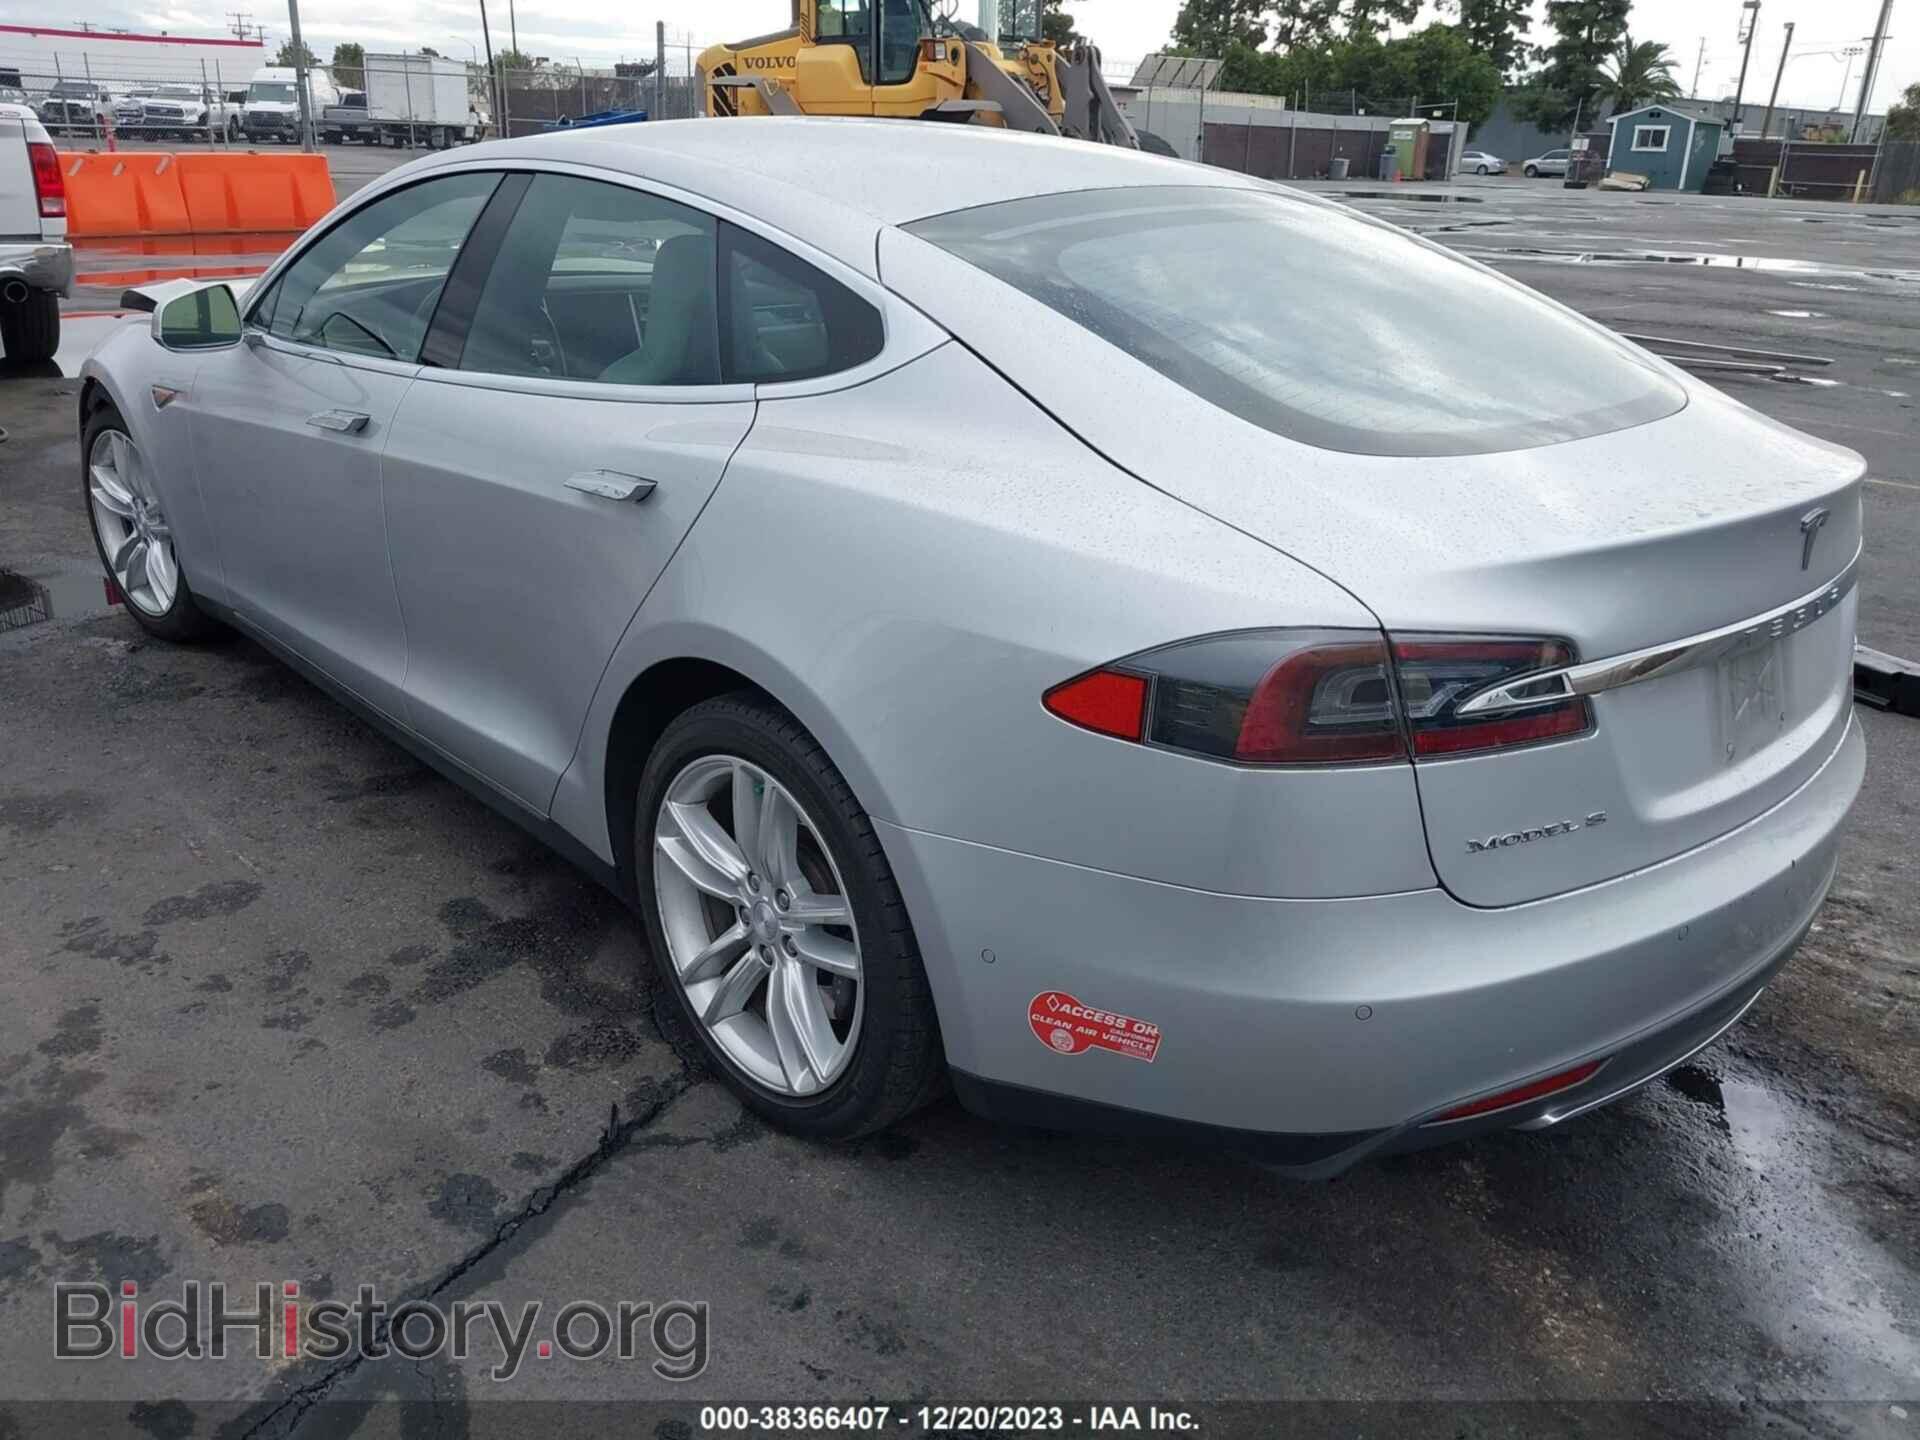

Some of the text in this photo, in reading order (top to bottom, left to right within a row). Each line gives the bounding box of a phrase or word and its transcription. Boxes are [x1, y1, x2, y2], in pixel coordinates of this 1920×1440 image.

[743, 56, 796, 69] VOLVO
[1465, 810, 1606, 854] MODEL S
[1031, 1013, 1154, 1050] CLEAN AIR VEHICLE
[1060, 1003, 1127, 1029] ACCESS
